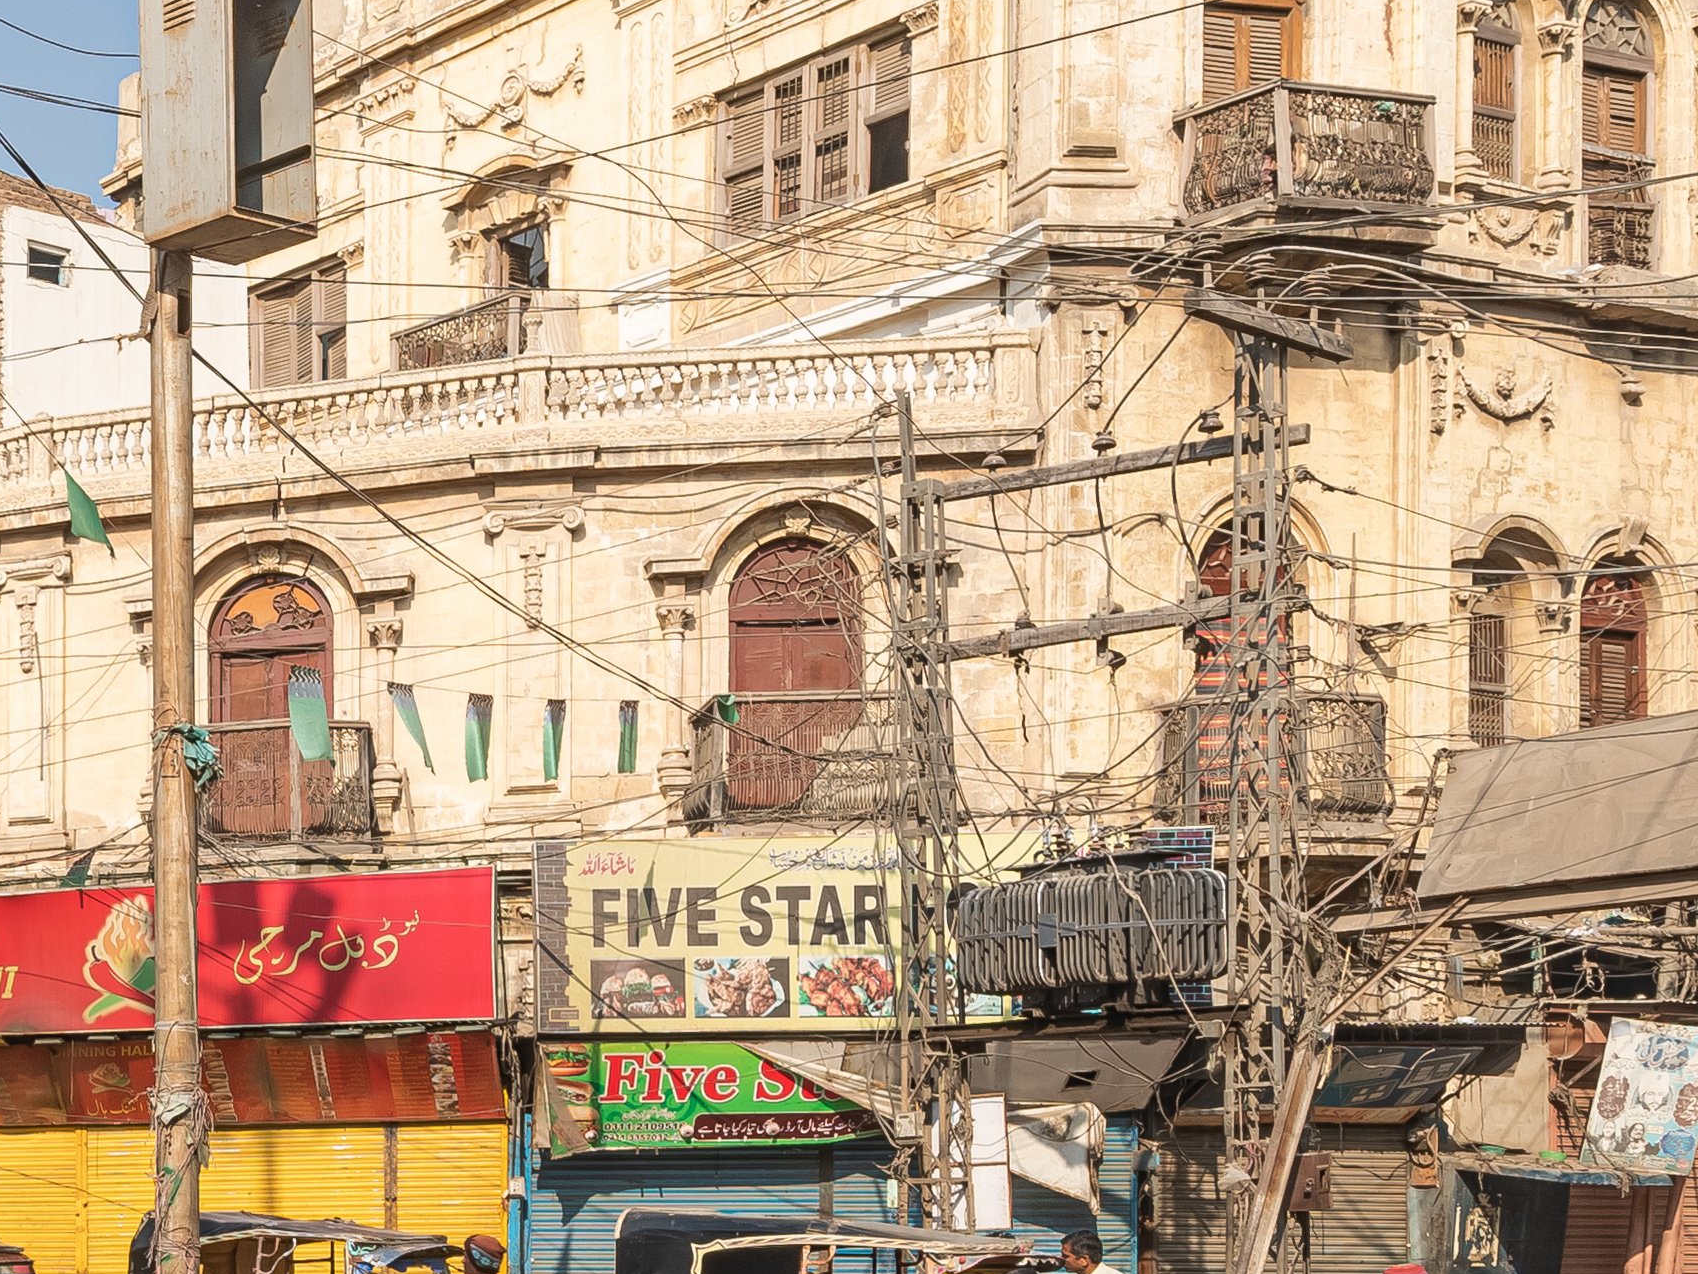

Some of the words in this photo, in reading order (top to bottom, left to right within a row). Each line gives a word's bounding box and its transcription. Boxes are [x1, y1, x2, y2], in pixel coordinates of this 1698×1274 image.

[592, 885, 718, 947] FIVE
[740, 884, 887, 947] STAR
[319, 917, 401, 972] ڈبل
[598, 1049, 738, 1104] Five
